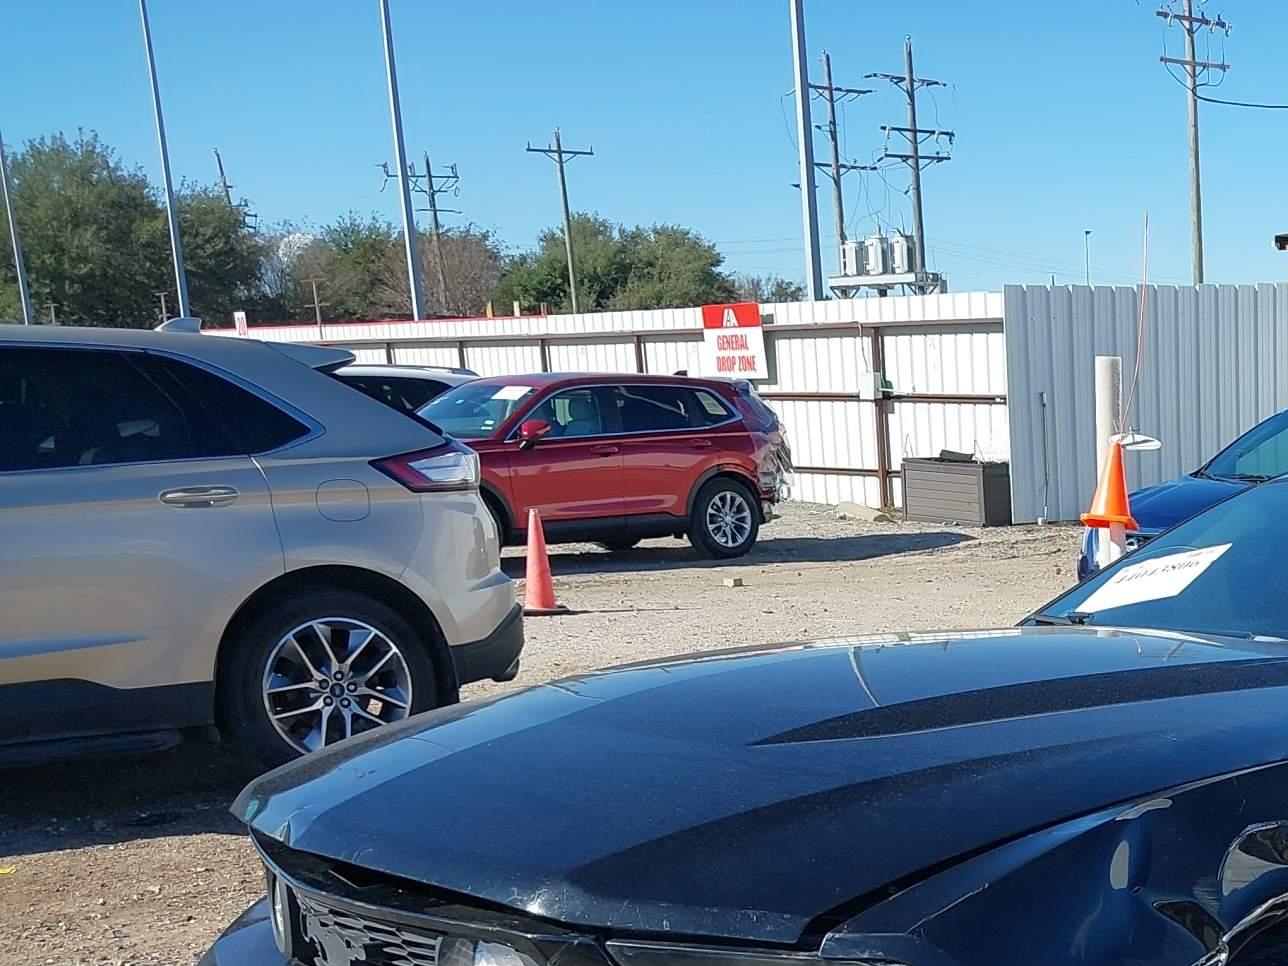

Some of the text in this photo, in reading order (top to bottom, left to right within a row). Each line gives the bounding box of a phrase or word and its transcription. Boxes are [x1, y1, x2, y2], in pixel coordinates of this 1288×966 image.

[717, 333, 749, 351] GENERAL
[716, 355, 757, 373] DROP ZONE
